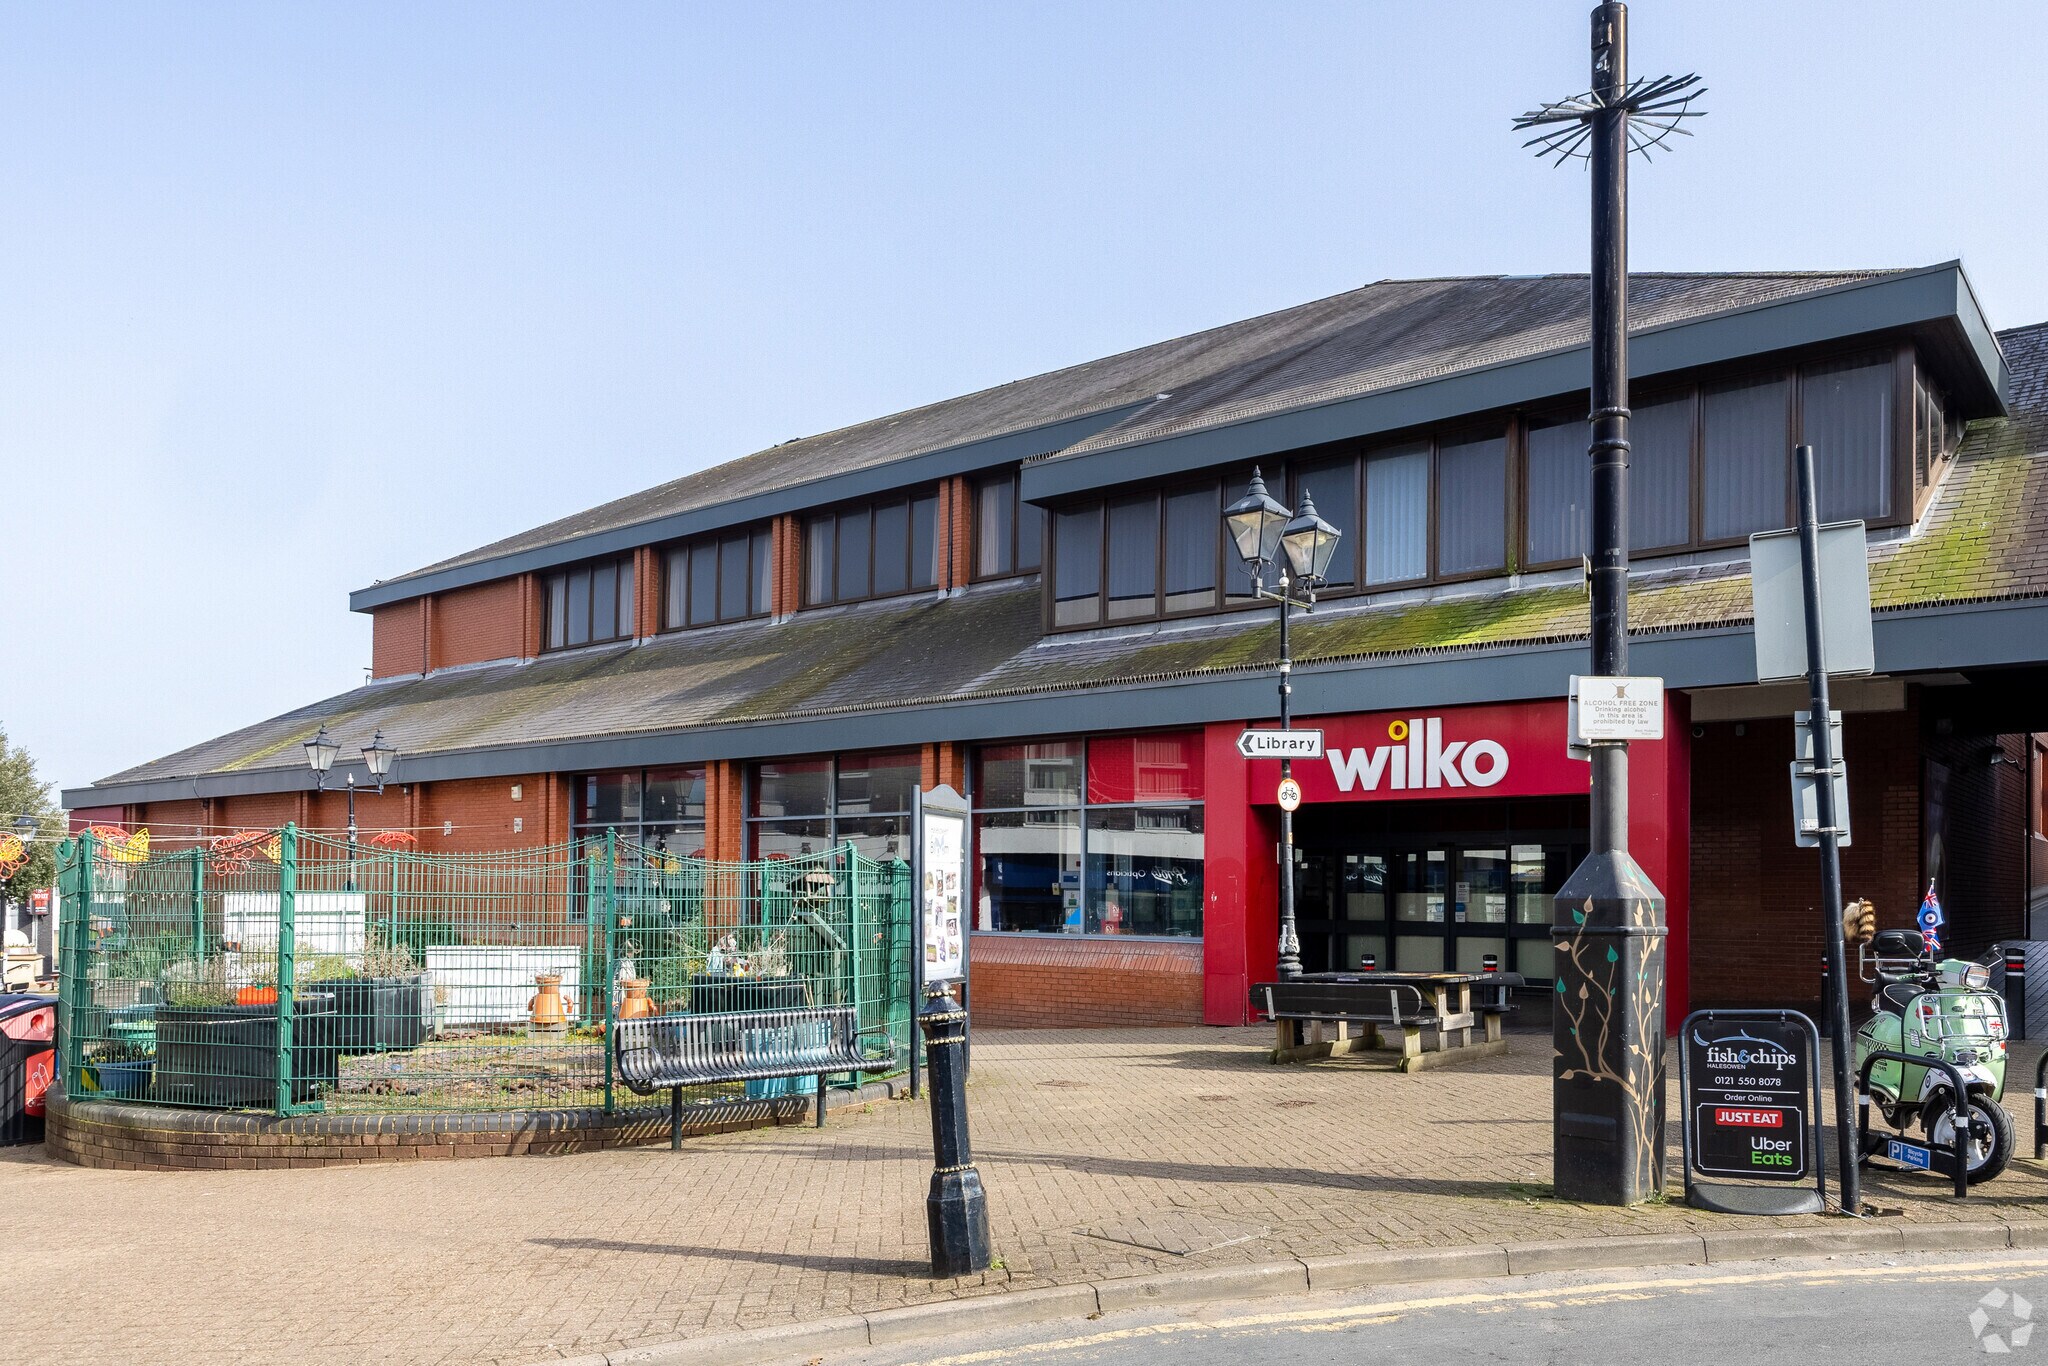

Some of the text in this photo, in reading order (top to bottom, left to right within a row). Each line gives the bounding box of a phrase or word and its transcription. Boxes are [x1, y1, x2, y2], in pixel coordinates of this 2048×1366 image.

[1257, 736, 1316, 752] Library
[1326, 717, 1510, 792] wilko
[1714, 1076, 1782, 1087] 0121 550 8078
[1724, 1093, 1773, 1102] Order Online
[1718, 1111, 1778, 1124] JUST EAT
[1751, 1136, 1793, 1151] Uber
[1751, 1151, 1793, 1166] Eats
